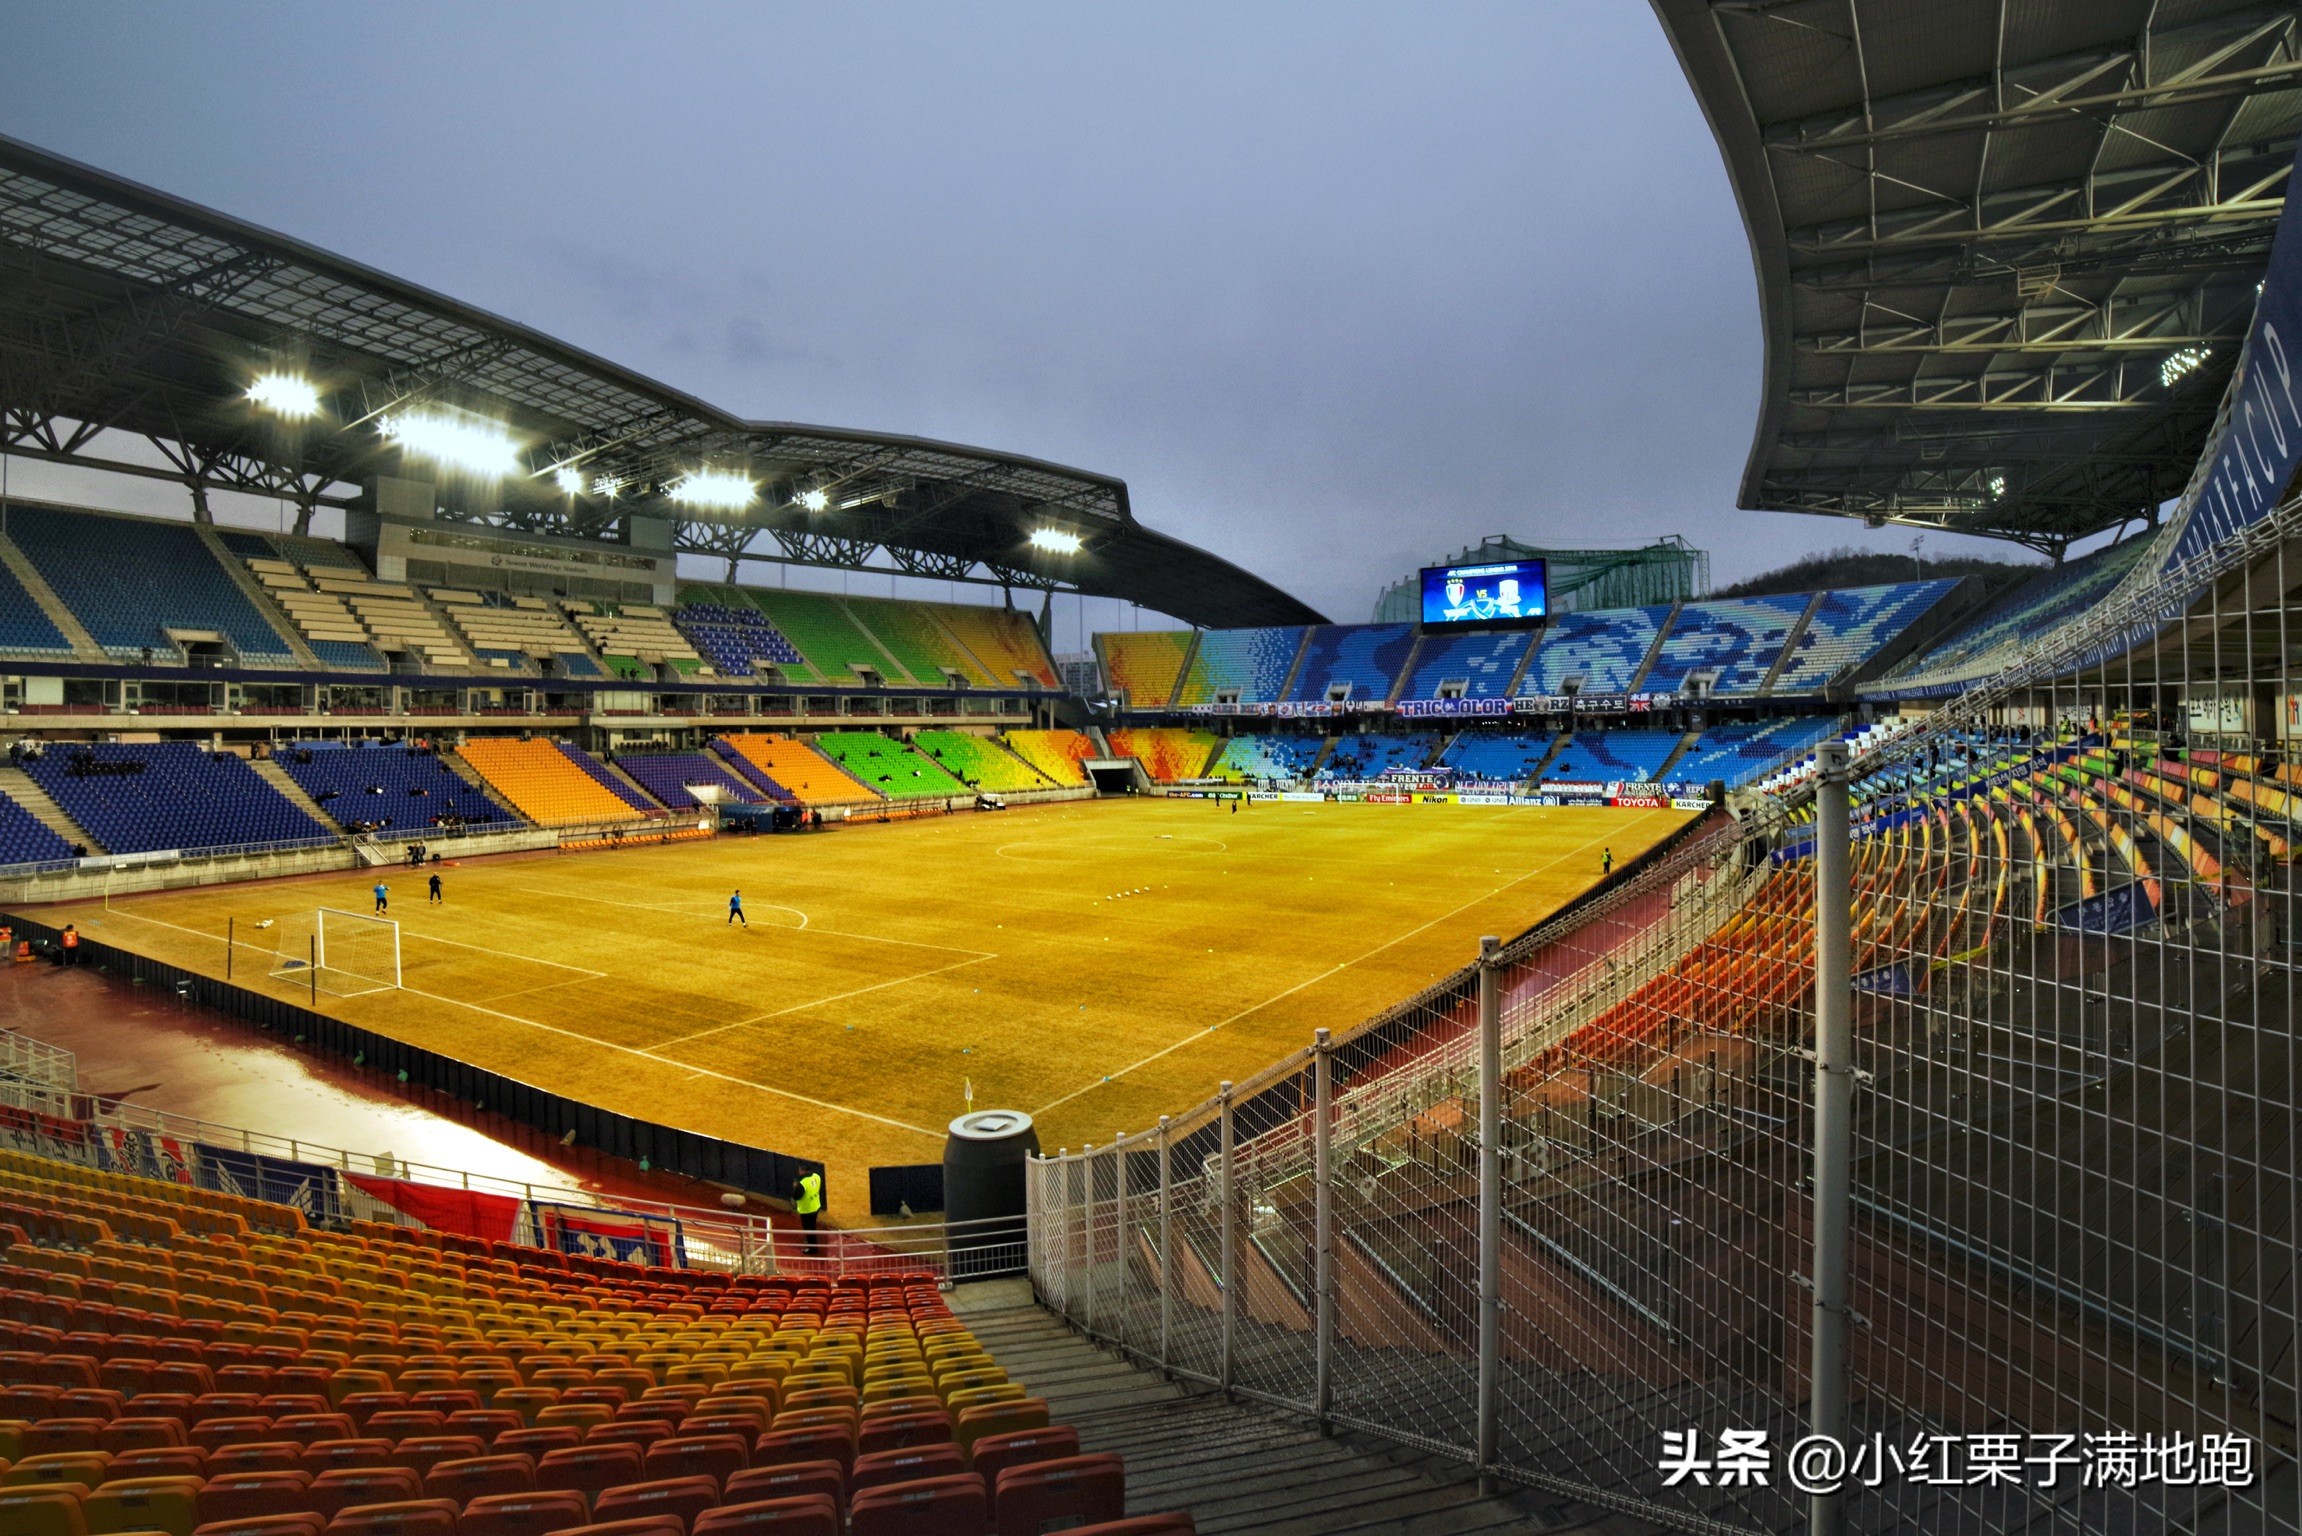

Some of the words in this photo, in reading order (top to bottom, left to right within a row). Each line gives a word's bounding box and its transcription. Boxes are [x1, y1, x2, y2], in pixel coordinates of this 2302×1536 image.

[504, 559, 527, 567] Suwon
[528, 561, 549, 569] World
[549, 564, 561, 572] Cup
[563, 565, 588, 573] Stadium
[1476, 589, 1488, 598] VS
[1391, 775, 1433, 783] FRENTE
[1369, 795, 1380, 803] Fly
[1381, 795, 1410, 803] Emirates
[1422, 795, 1448, 804] Nikon
[1508, 796, 1541, 806] Allianz
[1617, 797, 1659, 808] TOYOTA
